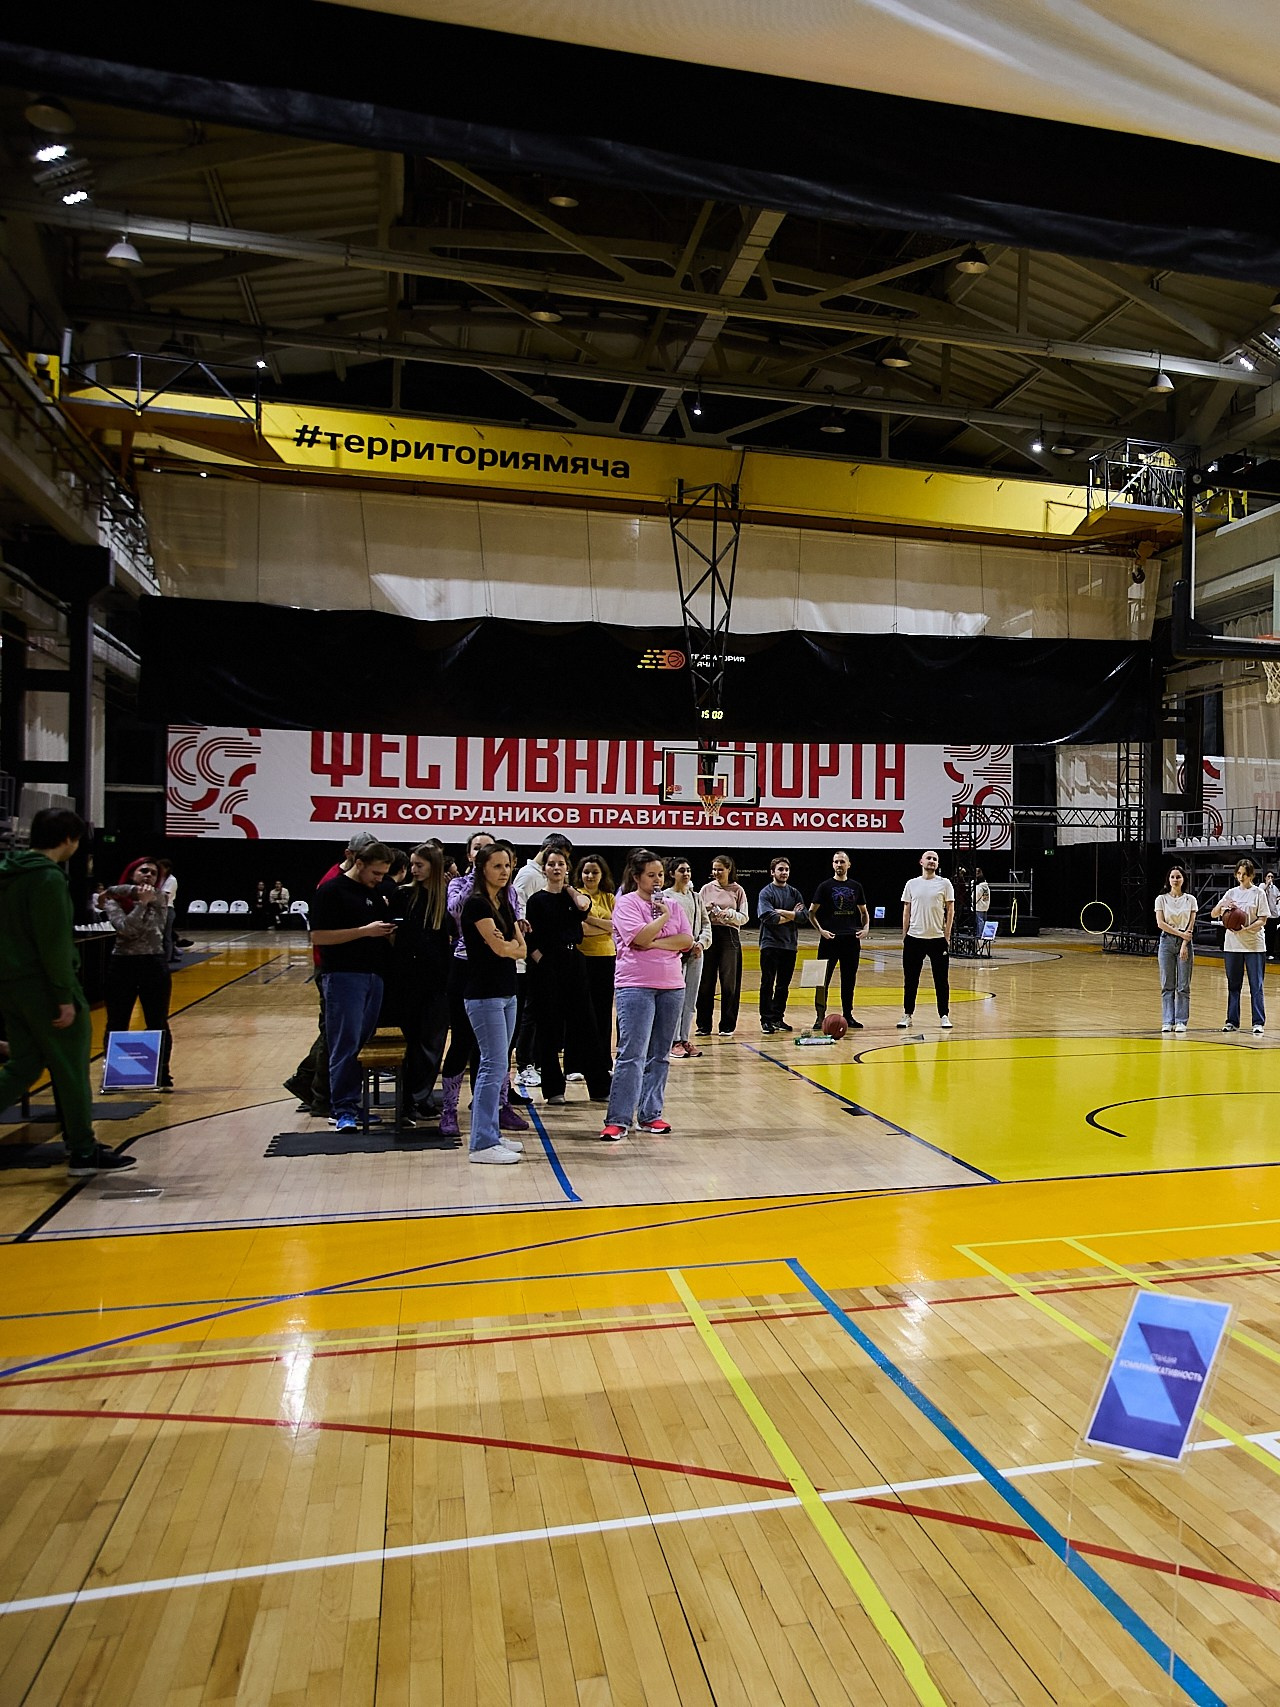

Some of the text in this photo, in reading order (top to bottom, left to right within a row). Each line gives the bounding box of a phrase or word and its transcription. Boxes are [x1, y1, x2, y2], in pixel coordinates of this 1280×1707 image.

[293, 424, 631, 479] #территориямяча
[335, 802, 887, 828] ДЛЯ СОТРУДНИКОВ ПРАВИТЕЛЬСТВА МОСКВЫ
